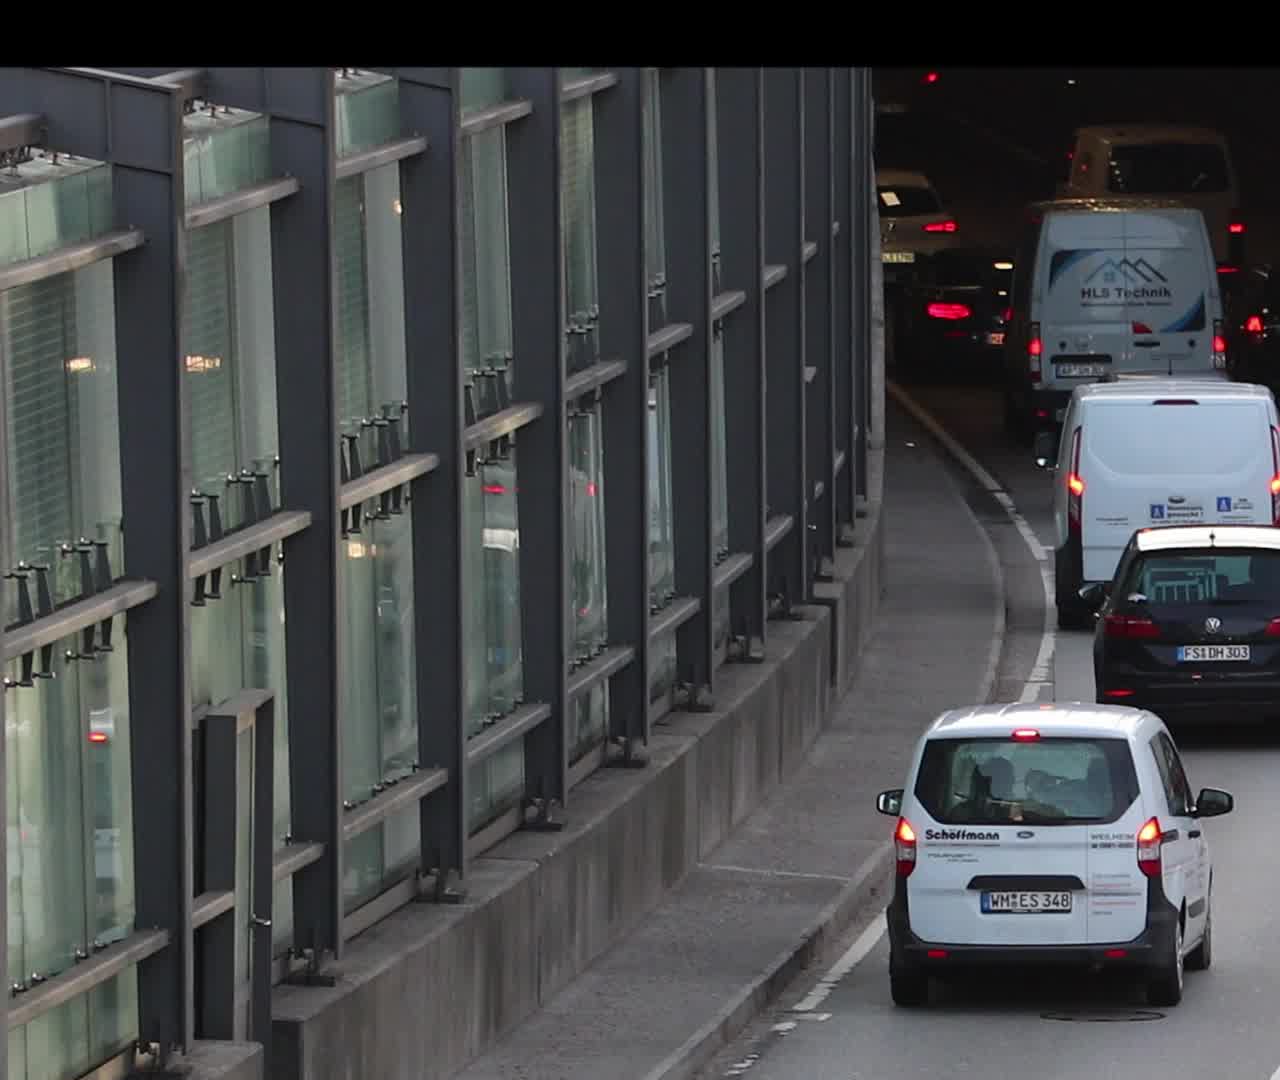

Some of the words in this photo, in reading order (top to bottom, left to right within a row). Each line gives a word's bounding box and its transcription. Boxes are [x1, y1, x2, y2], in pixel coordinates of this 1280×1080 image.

[1114, 287, 1172, 298] Technik
[1184, 647, 1200, 659] FS
[1208, 647, 1224, 658] DH
[1226, 647, 1249, 658] 303
[925, 828, 1000, 841] Schöffmann
[991, 894, 1011, 907] WM
[1019, 894, 1039, 908] ES
[1044, 893, 1069, 907] 348
